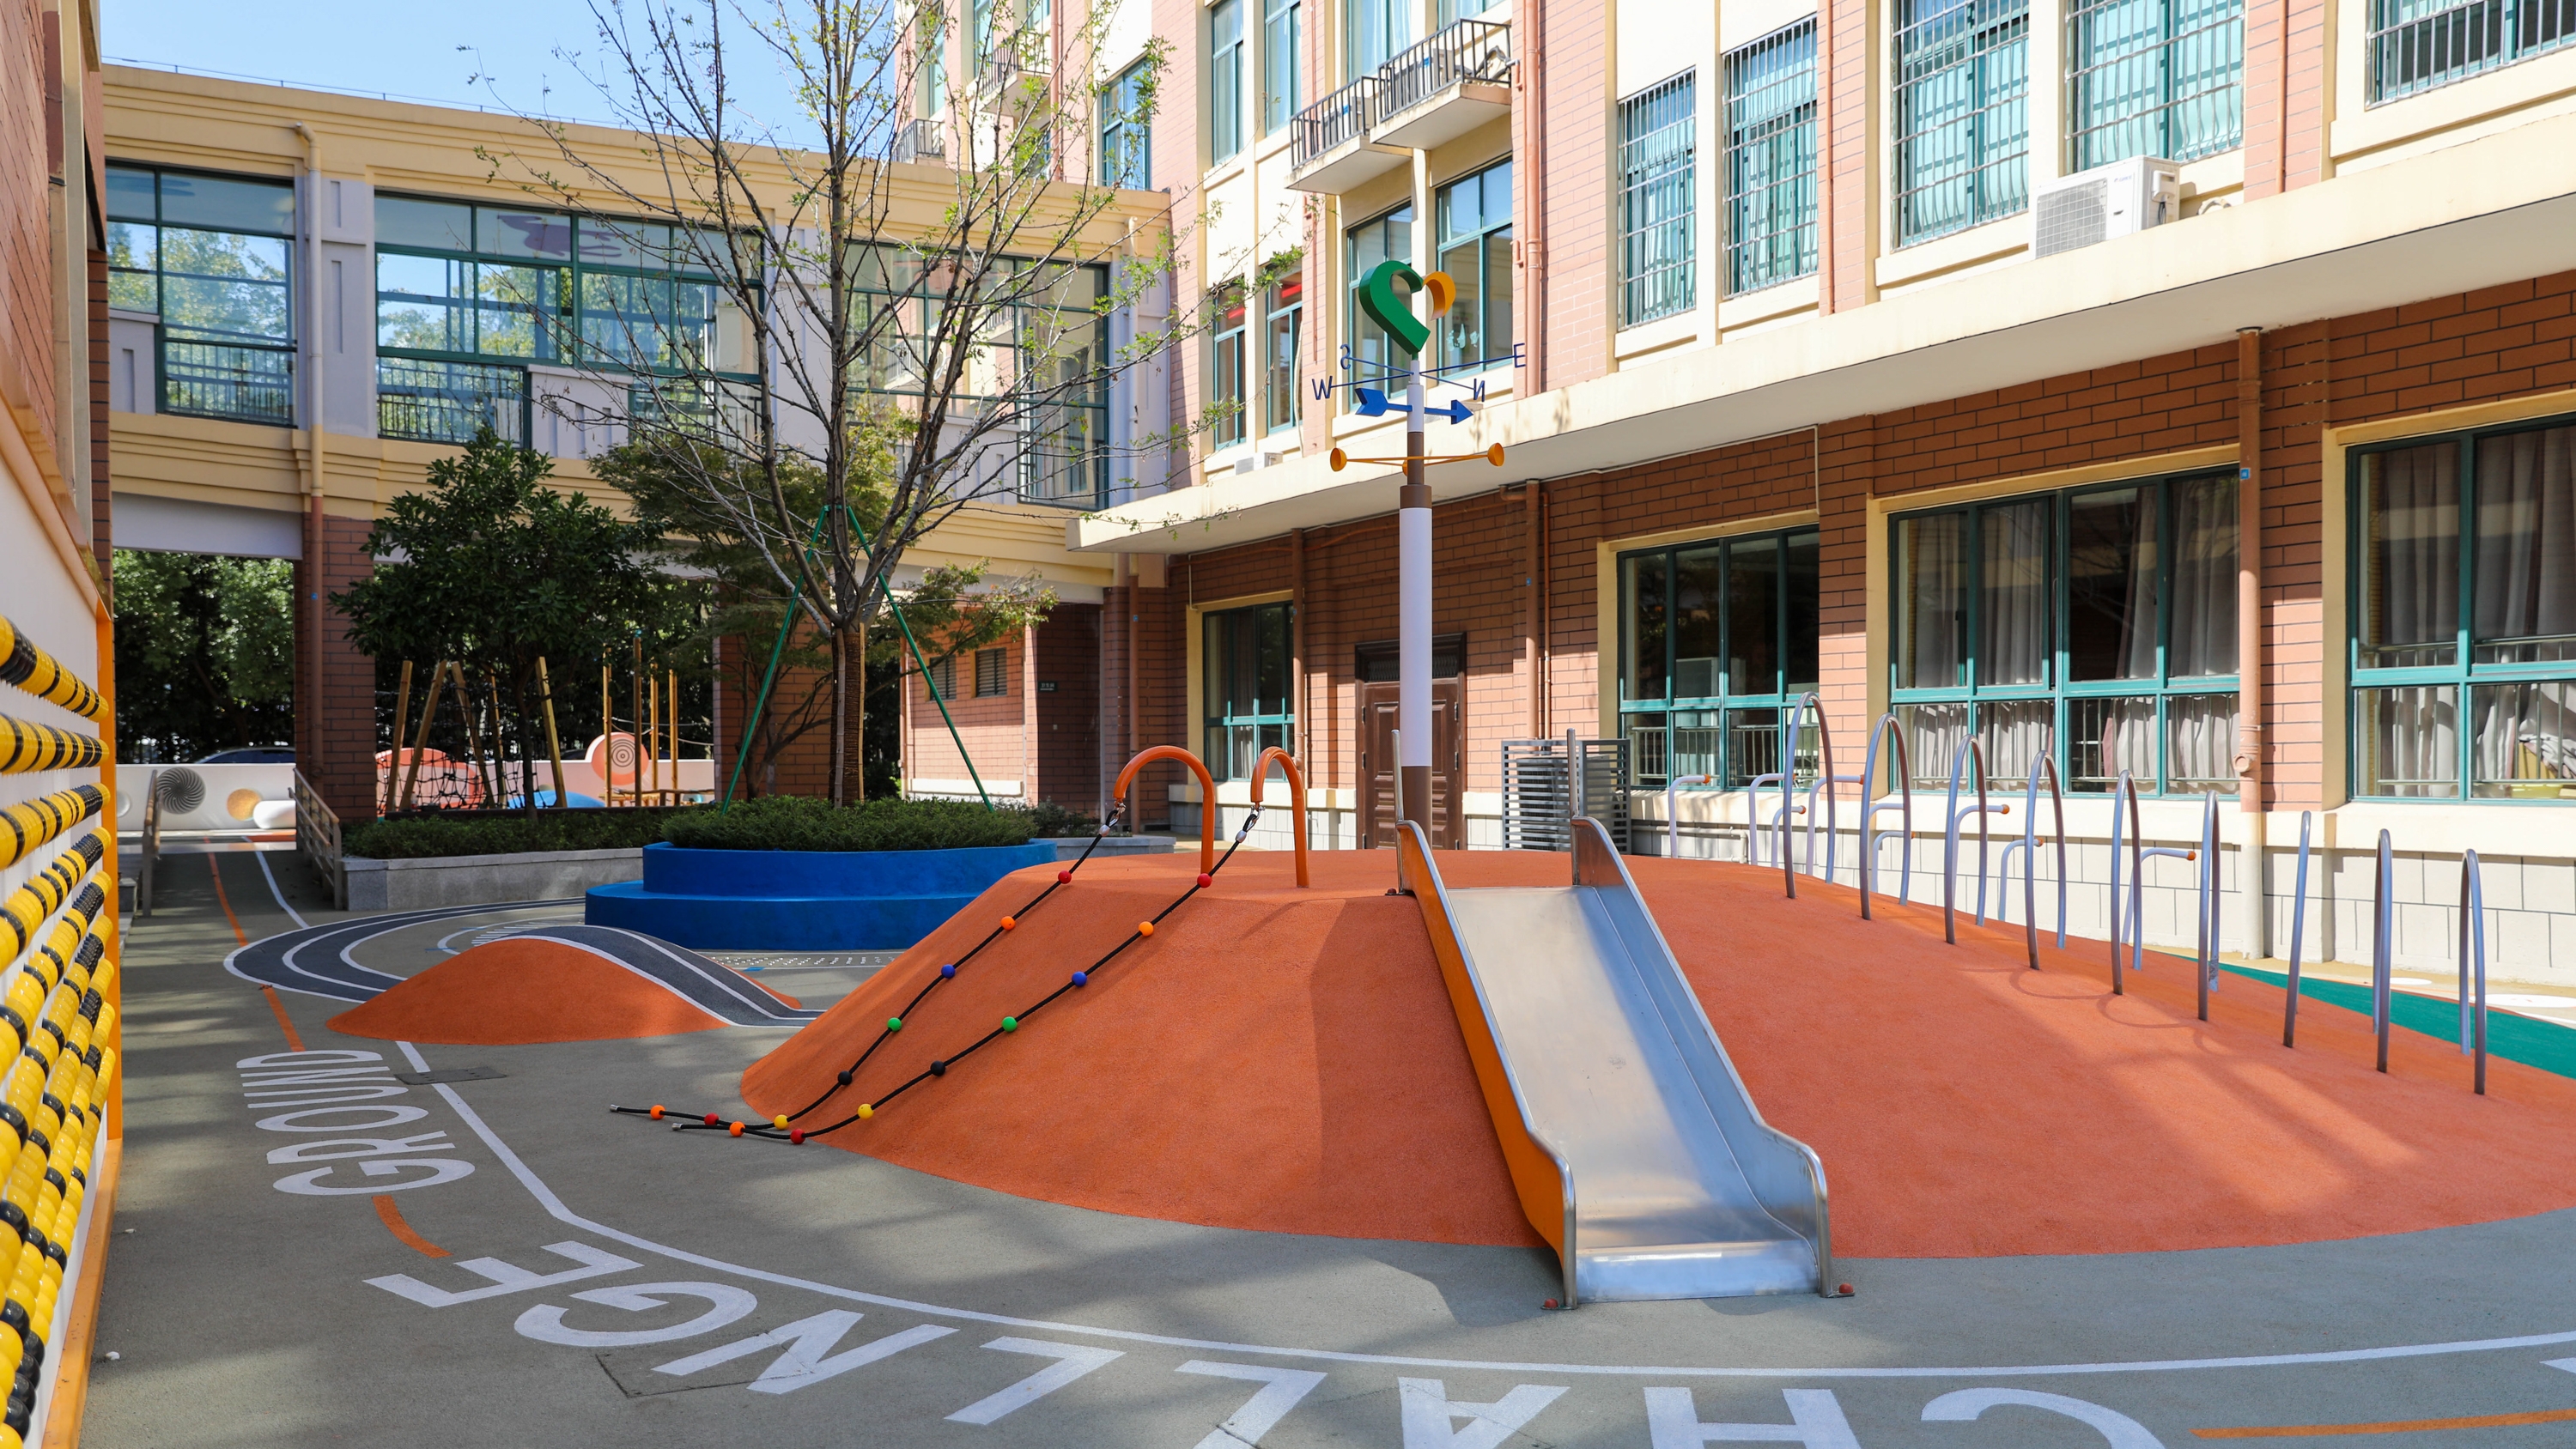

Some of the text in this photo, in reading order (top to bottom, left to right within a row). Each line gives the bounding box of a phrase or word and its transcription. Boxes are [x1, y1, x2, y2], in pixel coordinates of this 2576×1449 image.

[1513, 343, 1526, 368] E
[1312, 376, 1333, 400] W
[236, 1049, 476, 1196] GROUND
